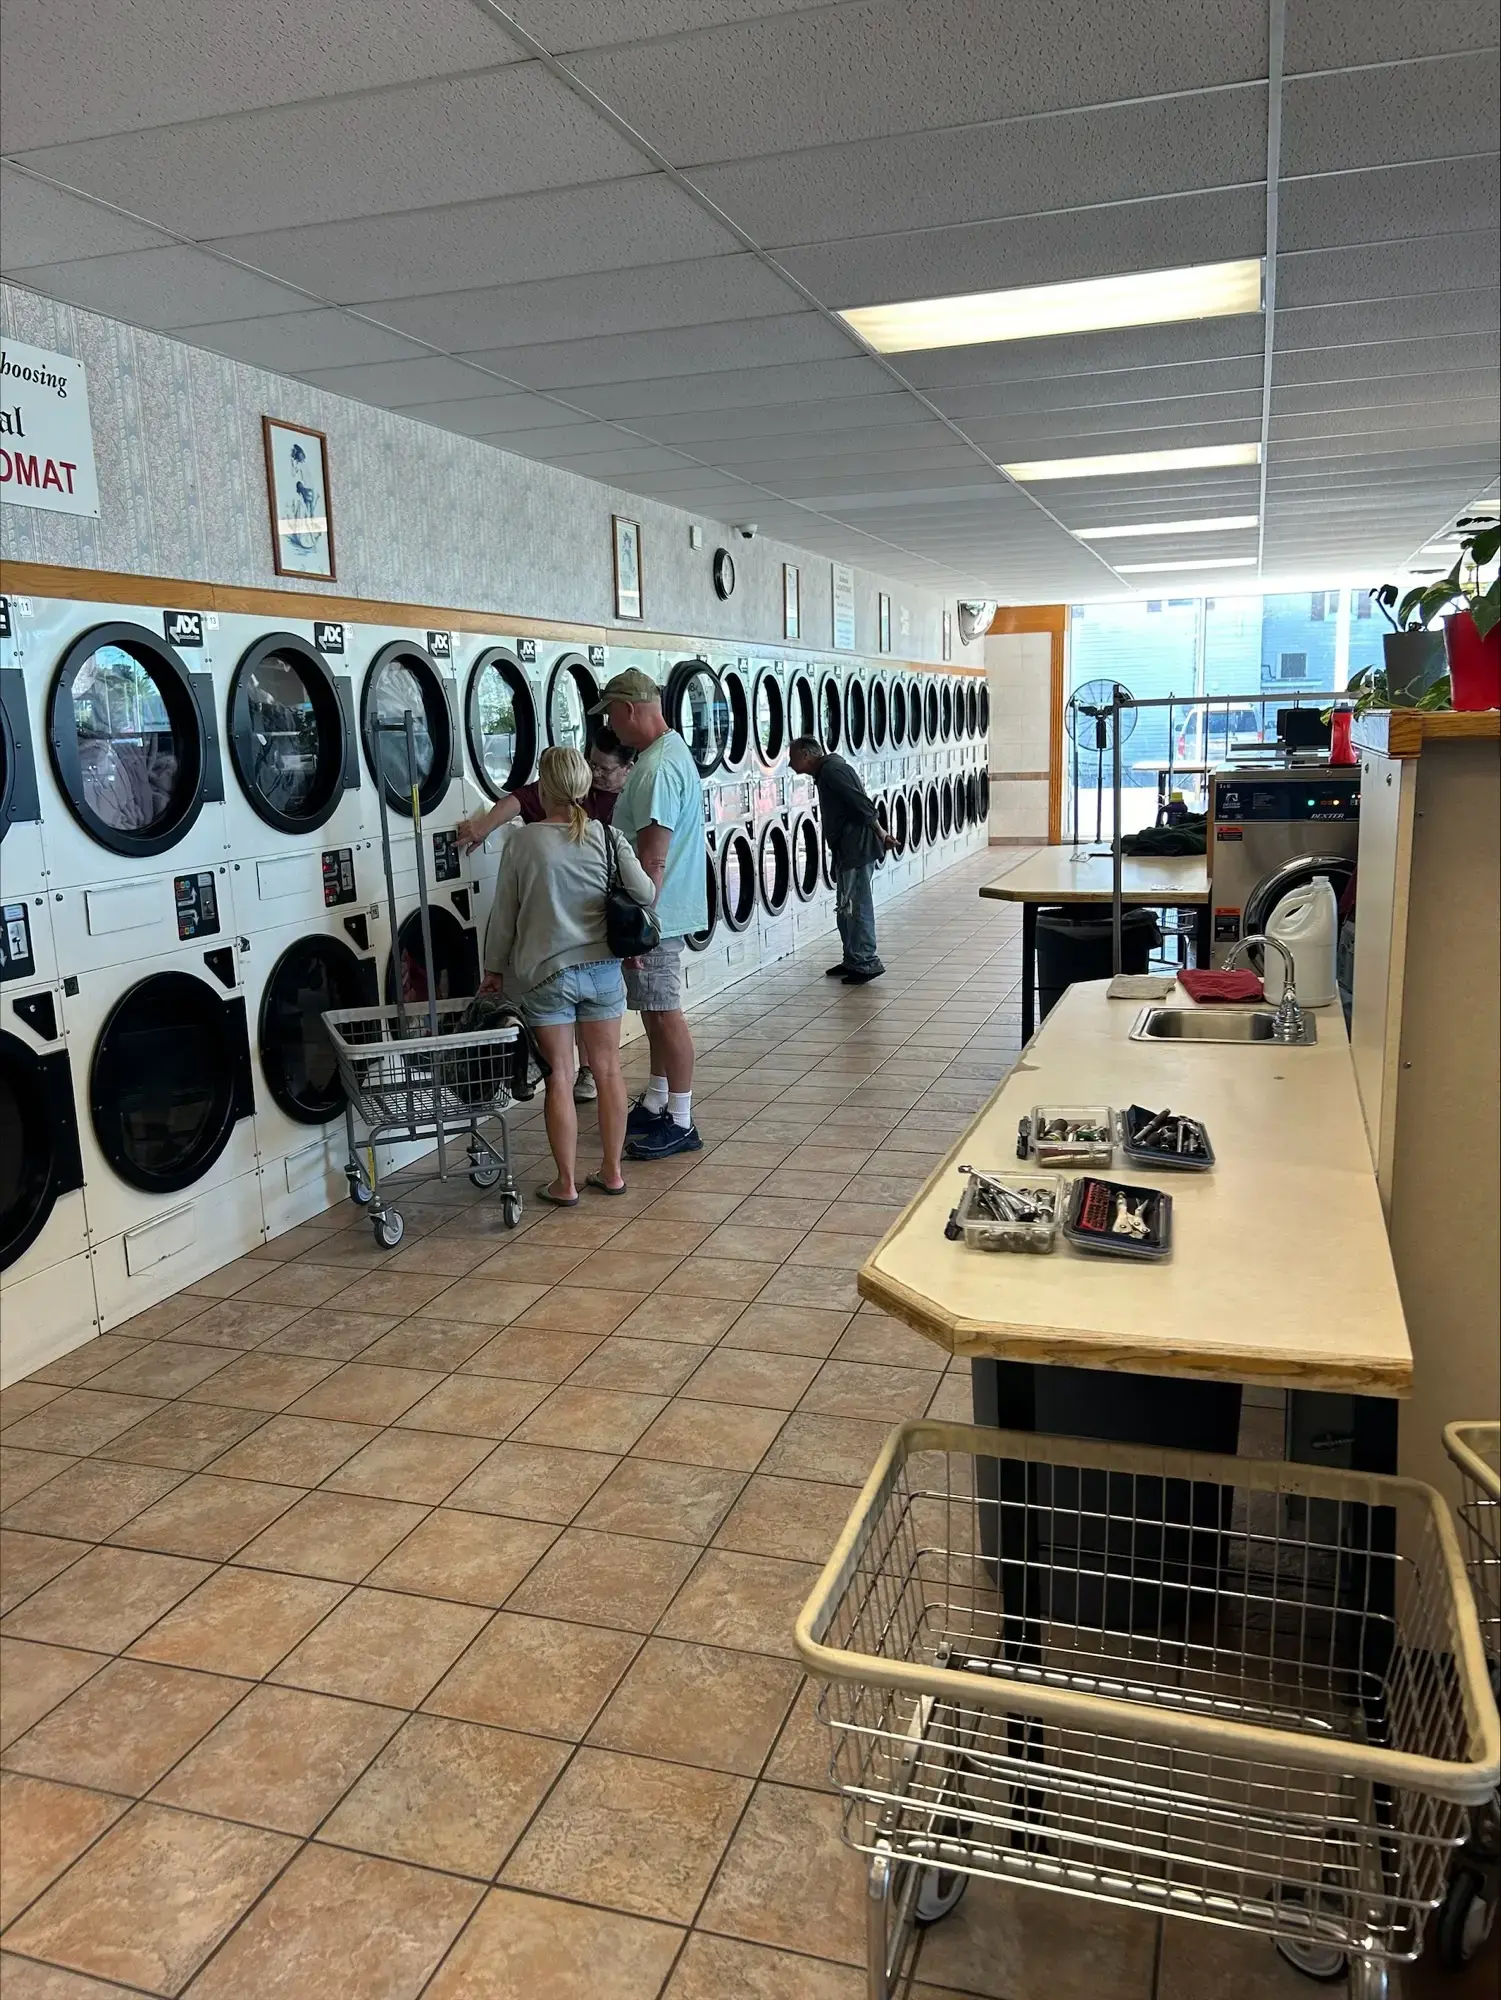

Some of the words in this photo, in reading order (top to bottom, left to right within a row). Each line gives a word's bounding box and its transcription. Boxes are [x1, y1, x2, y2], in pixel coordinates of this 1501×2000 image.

[0, 352, 68, 399] hoosing
[0, 405, 26, 438] al
[0, 448, 78, 495] OMAT
[176, 614, 200, 635] ADC
[323, 625, 342, 643] ADC
